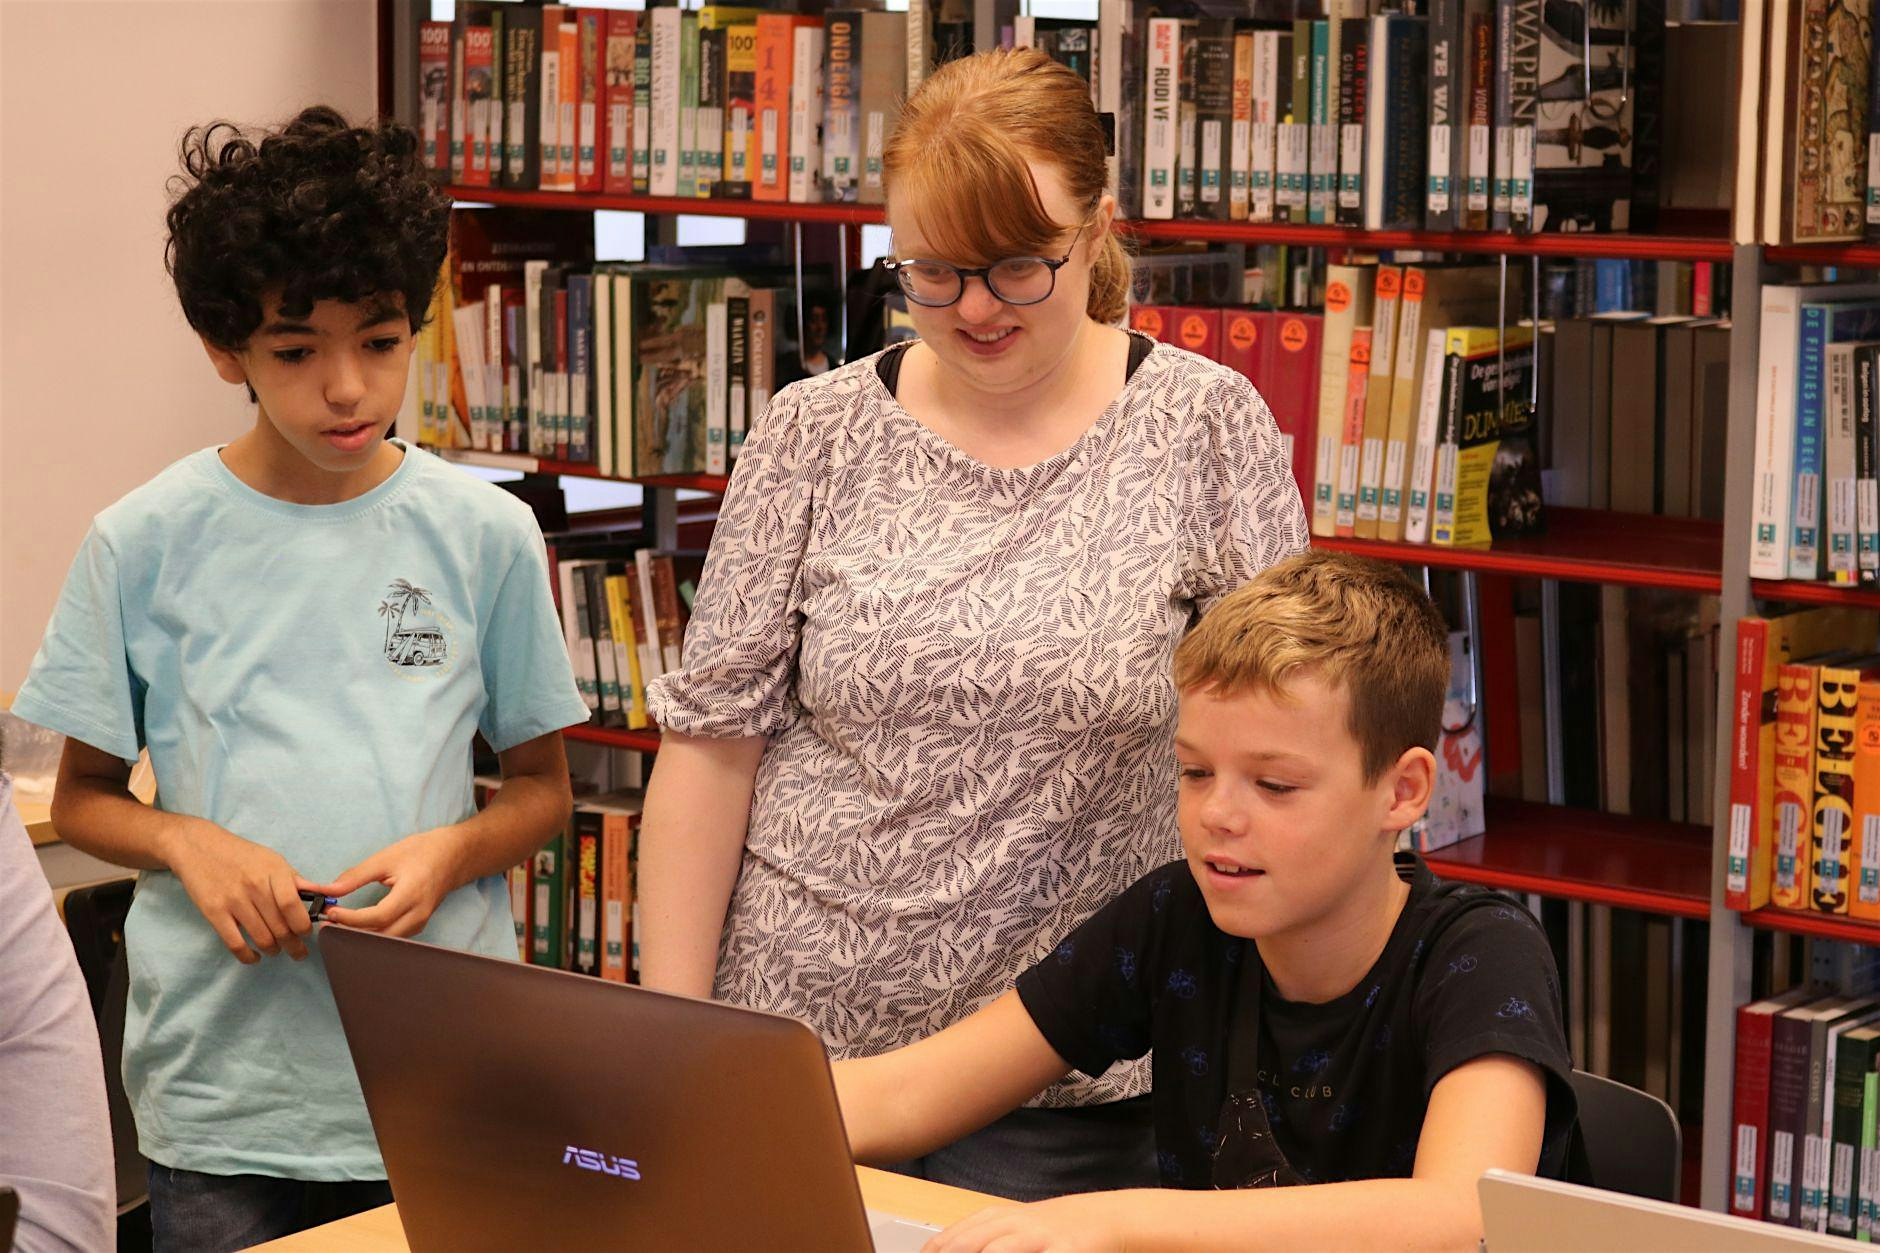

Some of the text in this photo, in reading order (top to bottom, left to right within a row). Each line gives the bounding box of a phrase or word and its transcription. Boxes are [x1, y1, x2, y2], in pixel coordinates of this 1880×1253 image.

[1434, 40, 1448, 77] TE
[1155, 68, 1170, 102] RUDI
[1804, 336, 1818, 400] FIFTIES
[1803, 408, 1815, 427] IN
[1740, 689, 1751, 725] Zonder
[562, 1145, 641, 1181] ASUS
